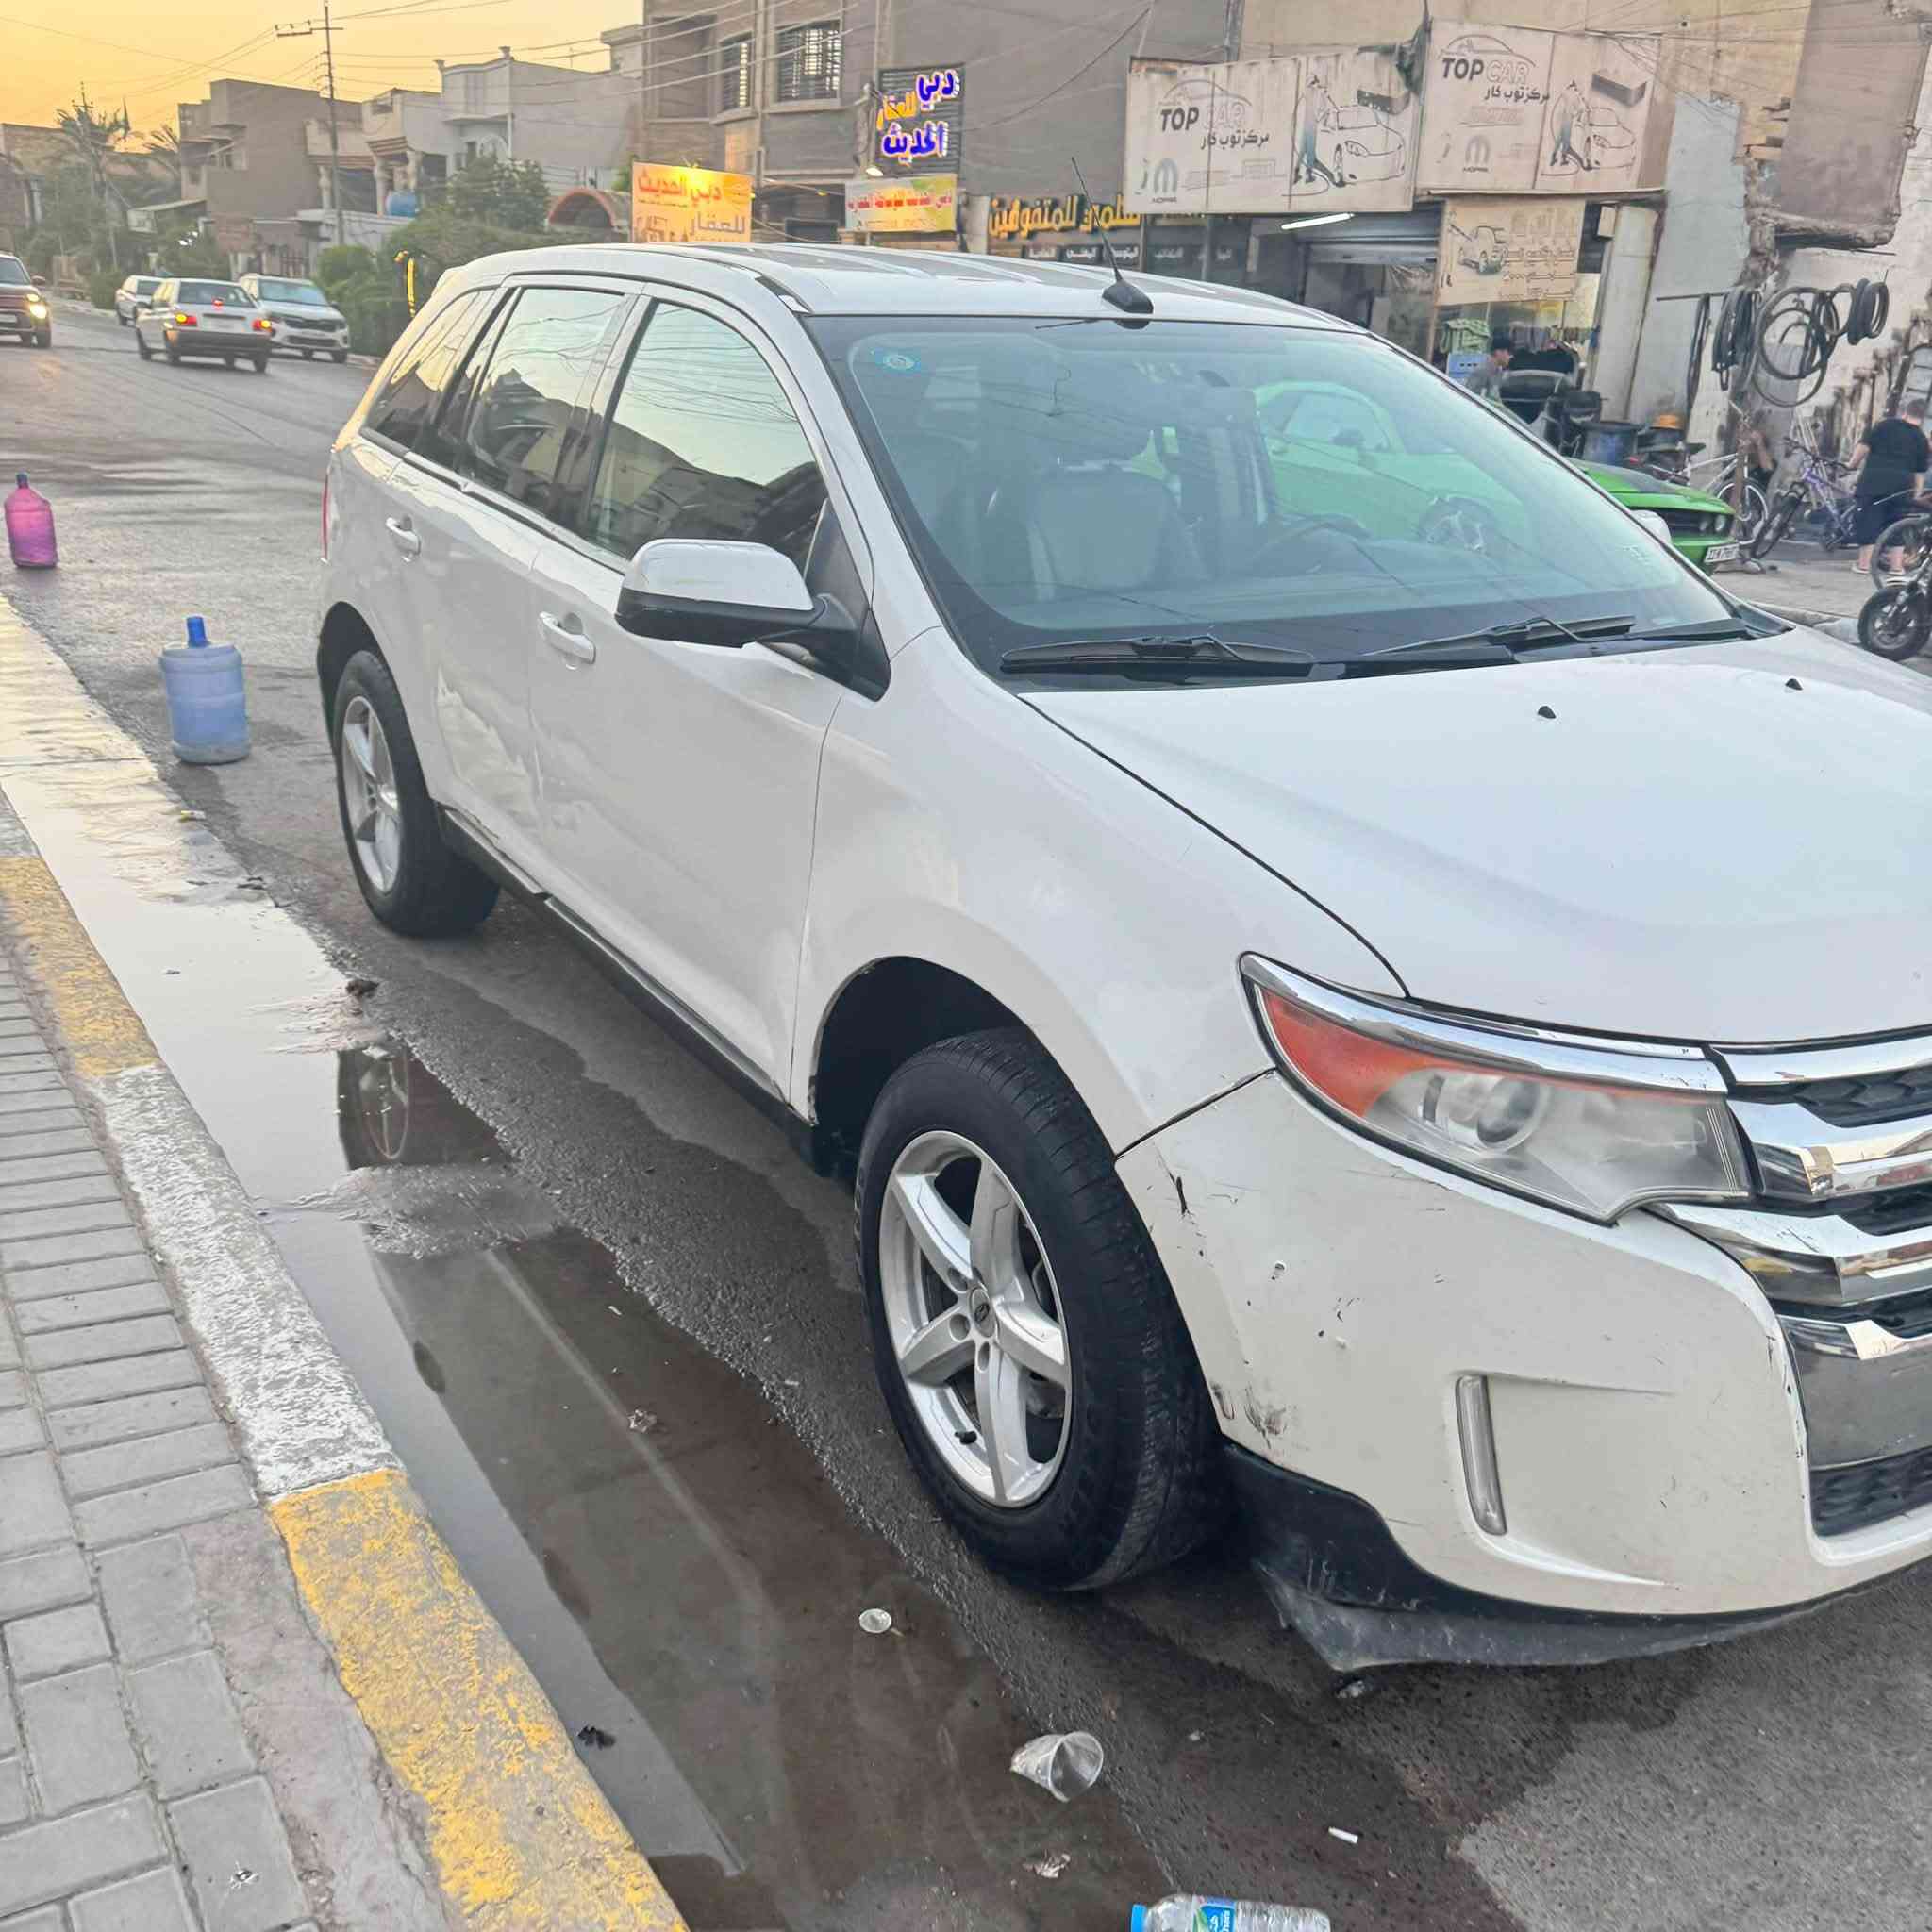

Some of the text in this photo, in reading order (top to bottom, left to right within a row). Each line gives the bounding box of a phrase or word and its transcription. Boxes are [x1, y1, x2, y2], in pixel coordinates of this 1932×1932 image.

[1442, 58, 1530, 84] TOP CAR
[916, 70, 959, 110] دبي
[1484, 84, 1550, 105] مركز توب كار
[1160, 107, 1200, 132] TOP
[881, 121, 948, 165] الحديث
[1200, 129, 1270, 150] مركز توب كار
[989, 194, 1078, 239] للمتفوقين
